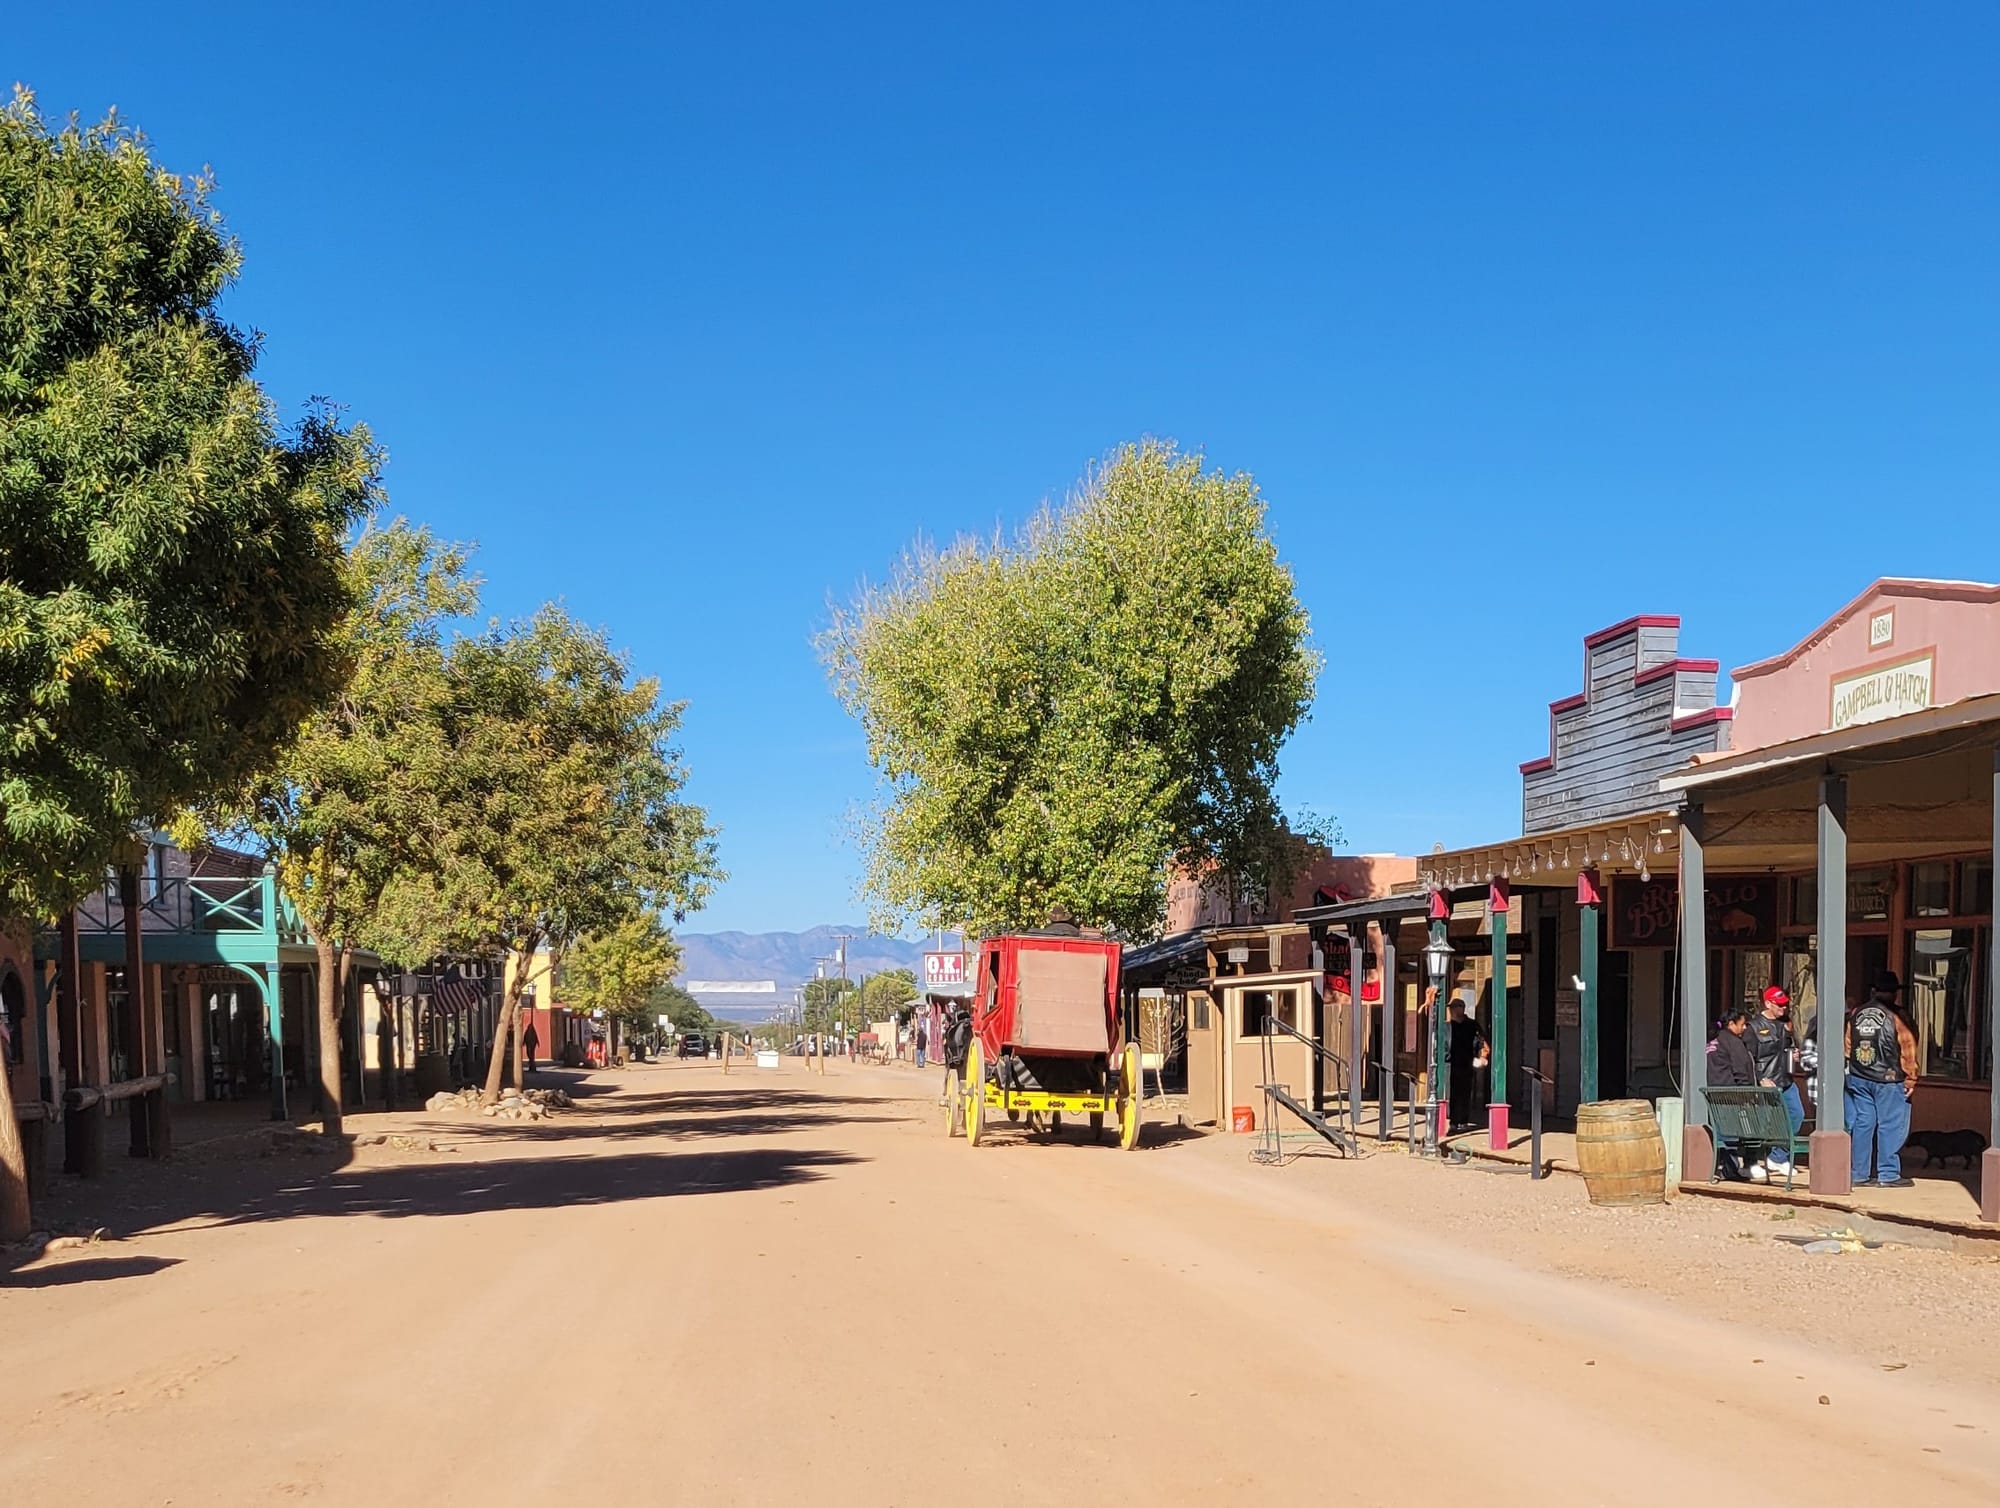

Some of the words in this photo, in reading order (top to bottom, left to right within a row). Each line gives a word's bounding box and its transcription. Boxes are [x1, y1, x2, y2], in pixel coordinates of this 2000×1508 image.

[1835, 677, 1883, 727] CAMPBELL
[1885, 675, 1894, 702] &
[1895, 671, 1928, 709] HATCH
[1627, 885, 1758, 939] BUALO
[928, 956, 960, 974] O.K.
